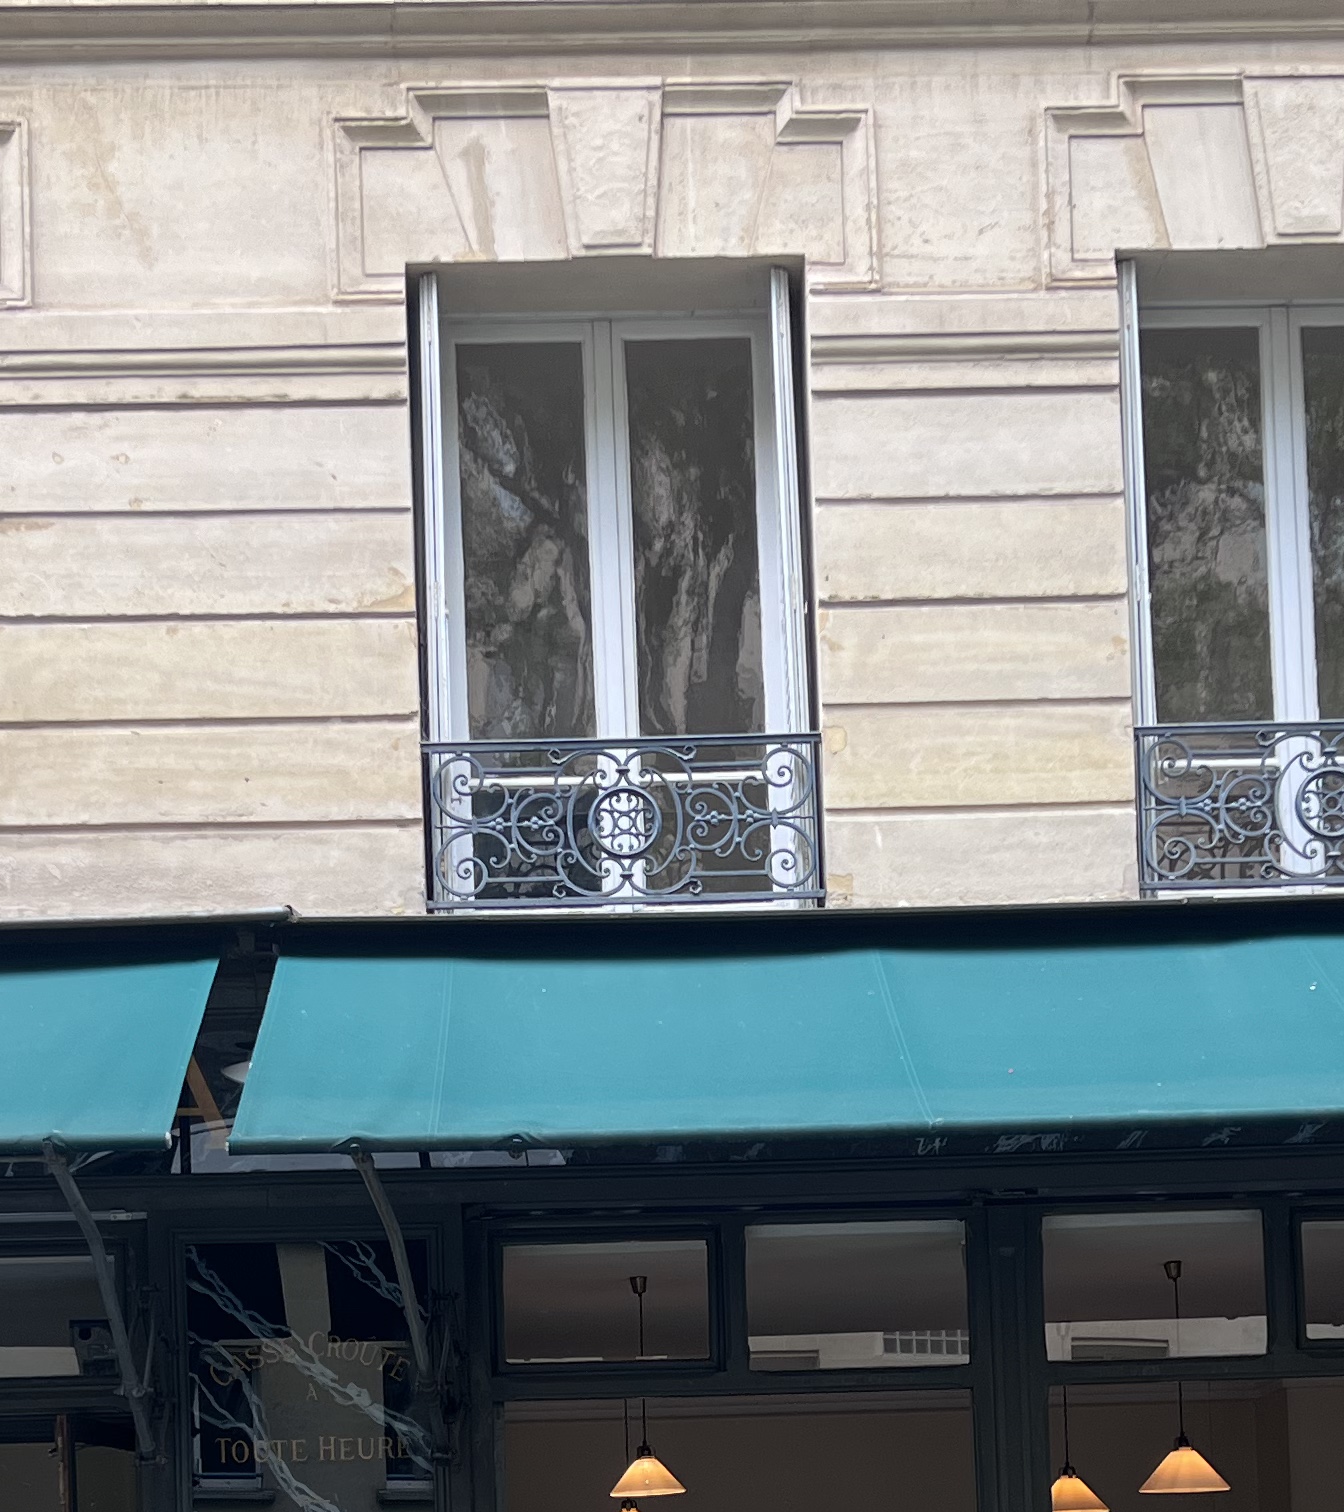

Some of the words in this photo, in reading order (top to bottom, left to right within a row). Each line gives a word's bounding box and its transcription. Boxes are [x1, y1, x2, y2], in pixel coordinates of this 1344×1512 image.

[209, 1338, 293, 1387] CASS
[215, 1437, 308, 1464] TOUTE
[318, 1435, 413, 1462] HEURE
